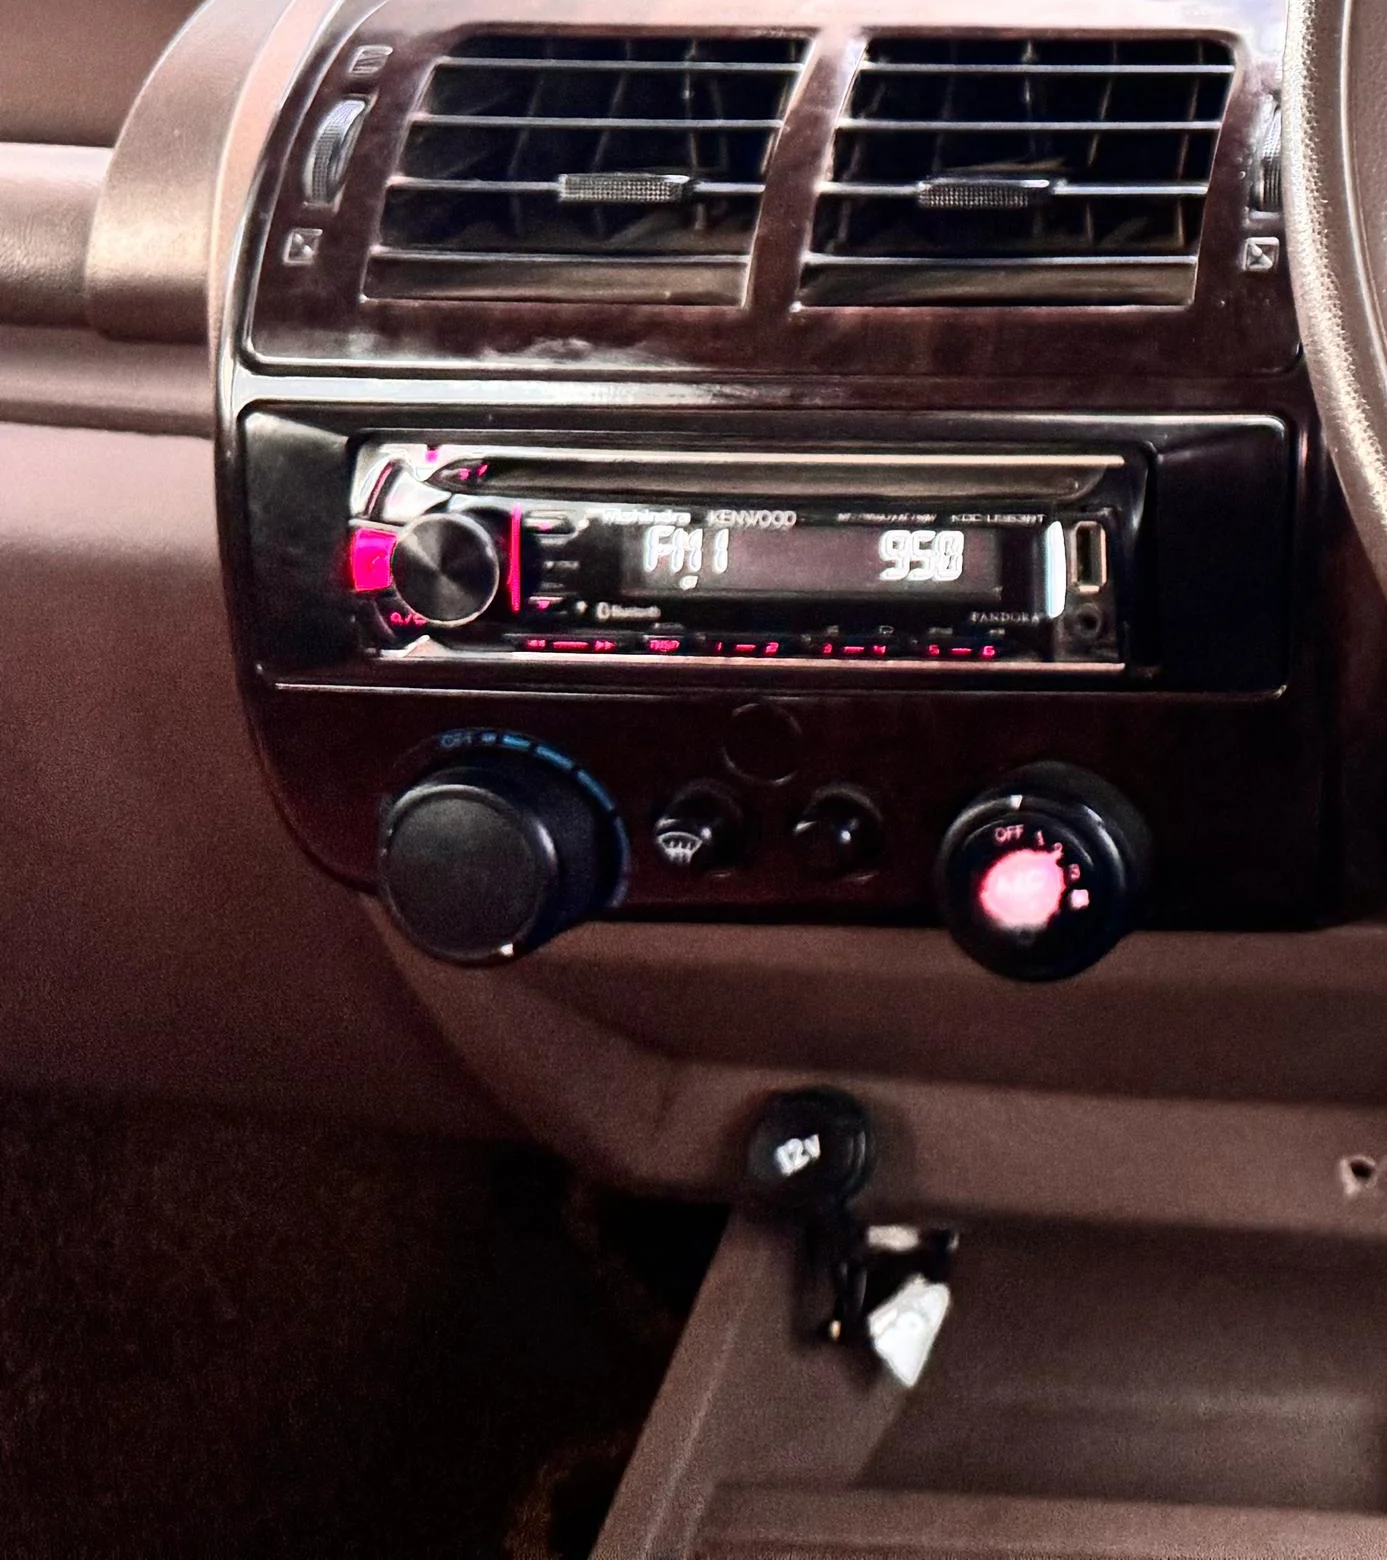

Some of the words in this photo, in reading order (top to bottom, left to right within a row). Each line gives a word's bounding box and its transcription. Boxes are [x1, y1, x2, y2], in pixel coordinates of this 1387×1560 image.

[706, 509, 797, 528] KENWOOD
[971, 611, 1041, 625] PANDORA
[995, 824, 1025, 843] OFF
